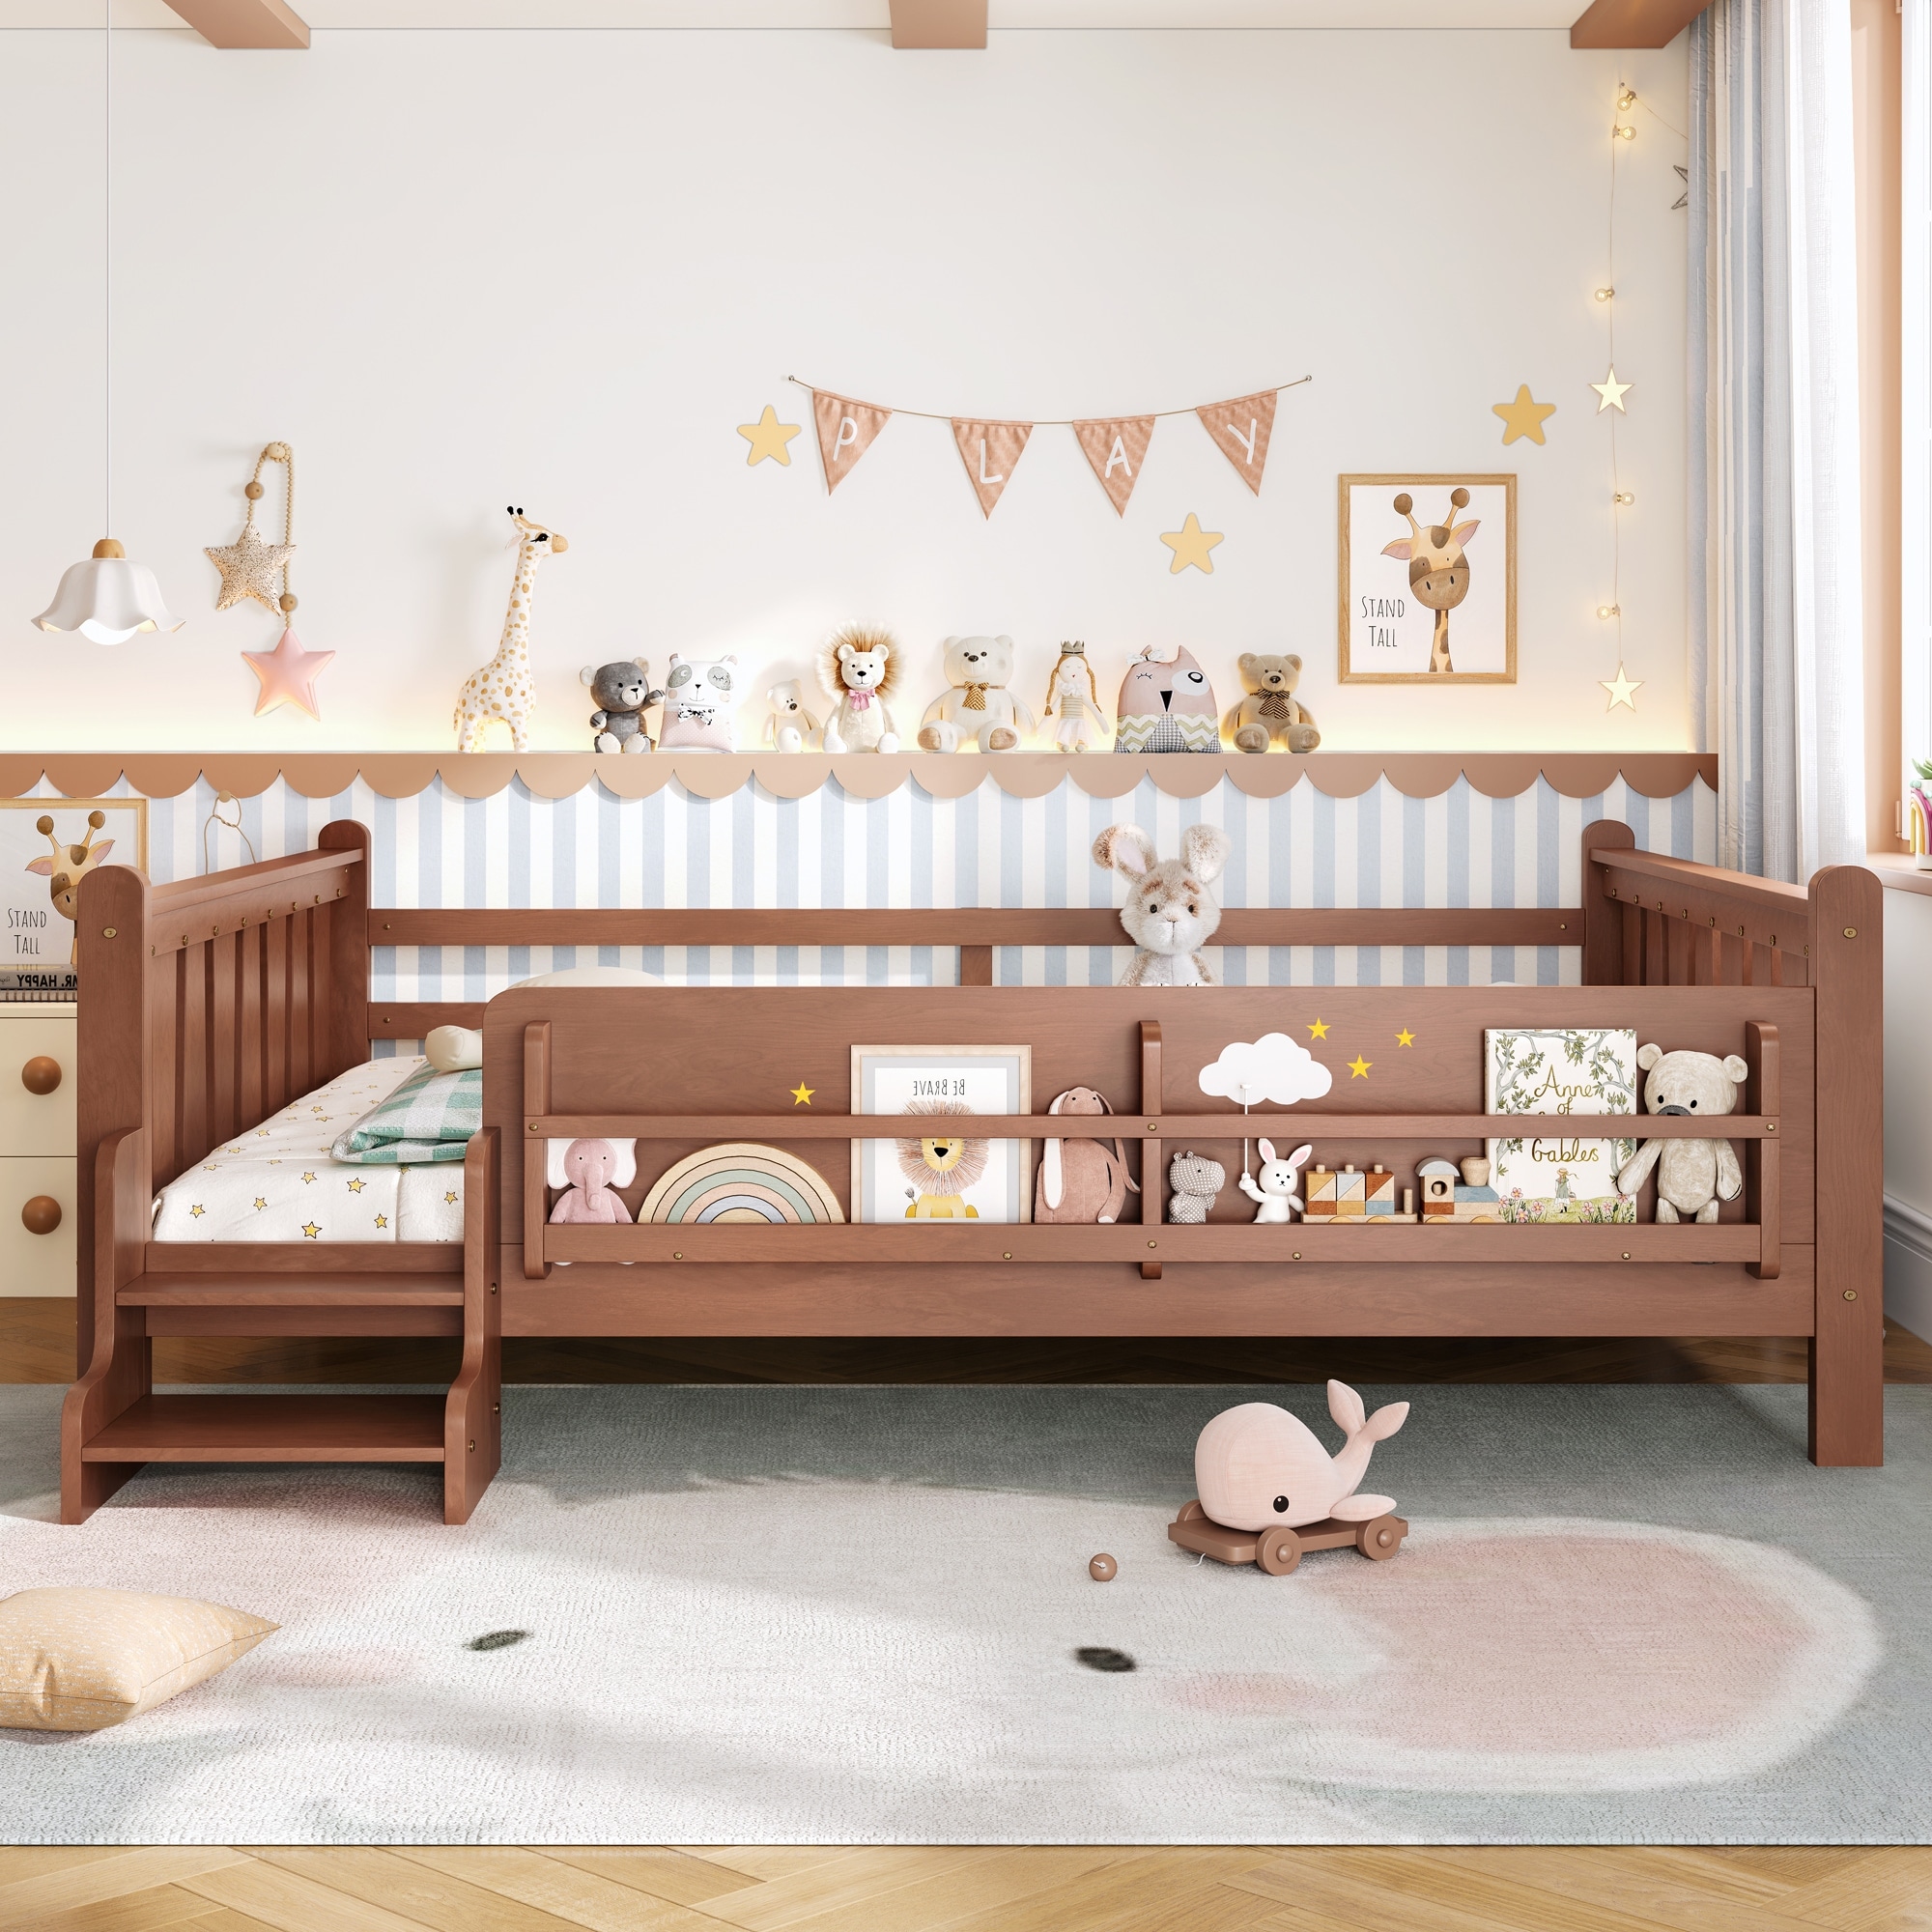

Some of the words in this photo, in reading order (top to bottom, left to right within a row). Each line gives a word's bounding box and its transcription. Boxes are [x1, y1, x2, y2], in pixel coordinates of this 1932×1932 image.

[1361, 595, 1405, 618] STAND
[1368, 625, 1398, 647] TALL
[8, 907, 47, 928] STAND
[14, 934, 41, 954] TALL
[1533, 1064, 1595, 1098] Anne
[1556, 1096, 1574, 1115] of
[1531, 1138, 1600, 1163] Gables
